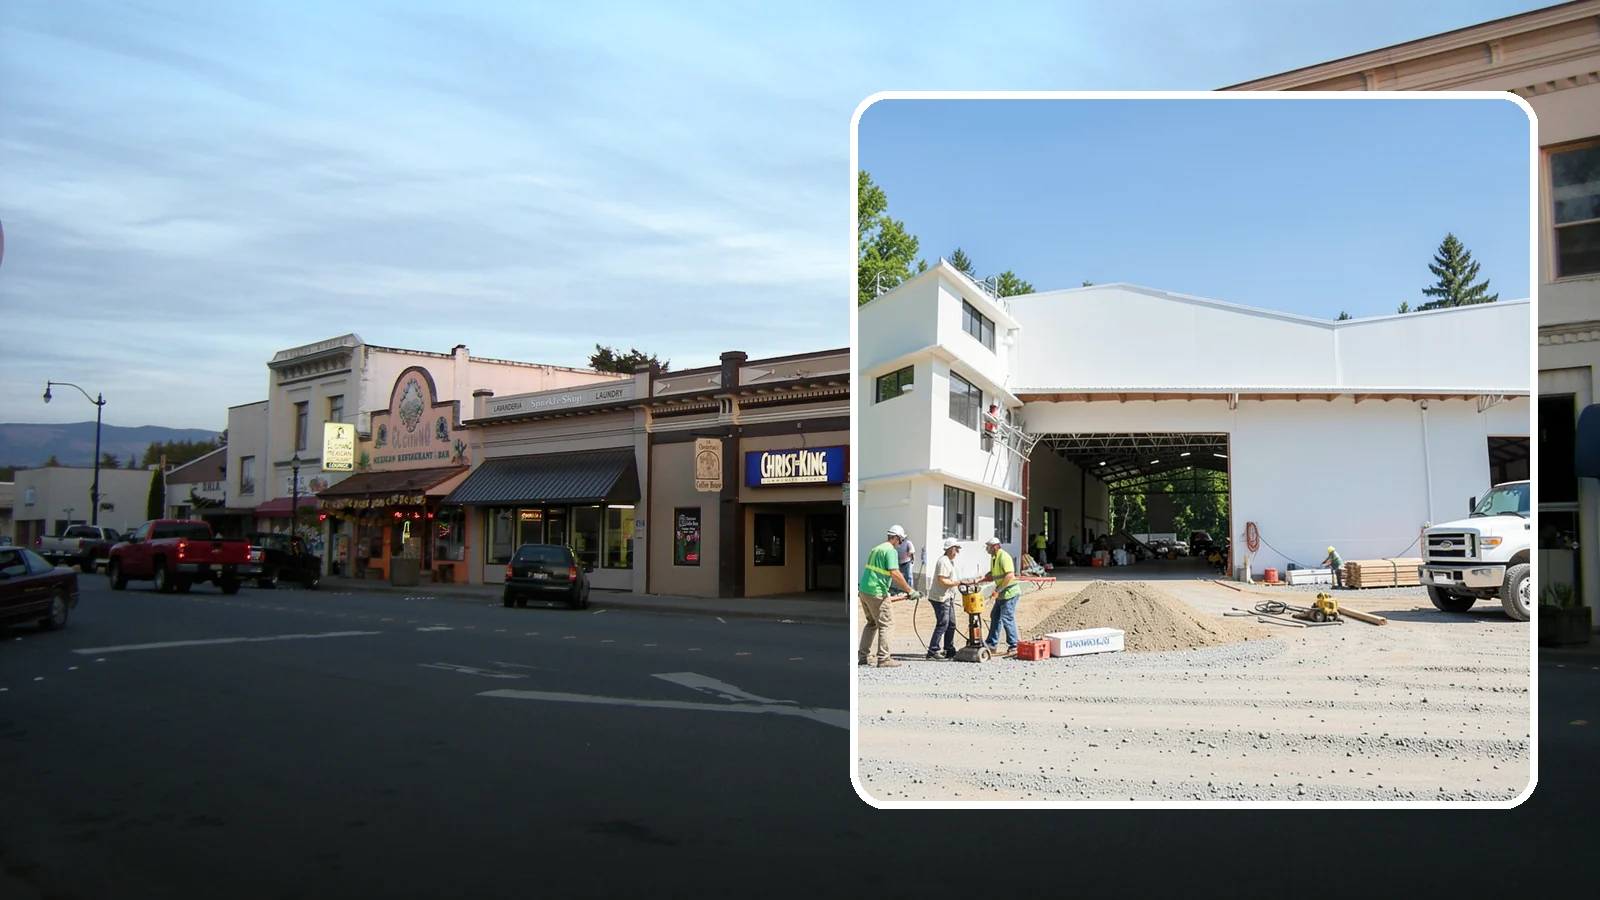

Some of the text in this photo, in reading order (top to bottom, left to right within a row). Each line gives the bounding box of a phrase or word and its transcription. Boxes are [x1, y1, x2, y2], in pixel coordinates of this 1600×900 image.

[595, 389, 623, 400] LAUNDRY
[493, 402, 522, 412] LAVANDERIA
[530, 395, 582, 409] Sparkle Shop
[373, 455, 396, 464] MEXICAN
[397, 452, 433, 462] RESTAURANT
[437, 450, 449, 459] BAR
[760, 449, 827, 478] CHRIST KING
